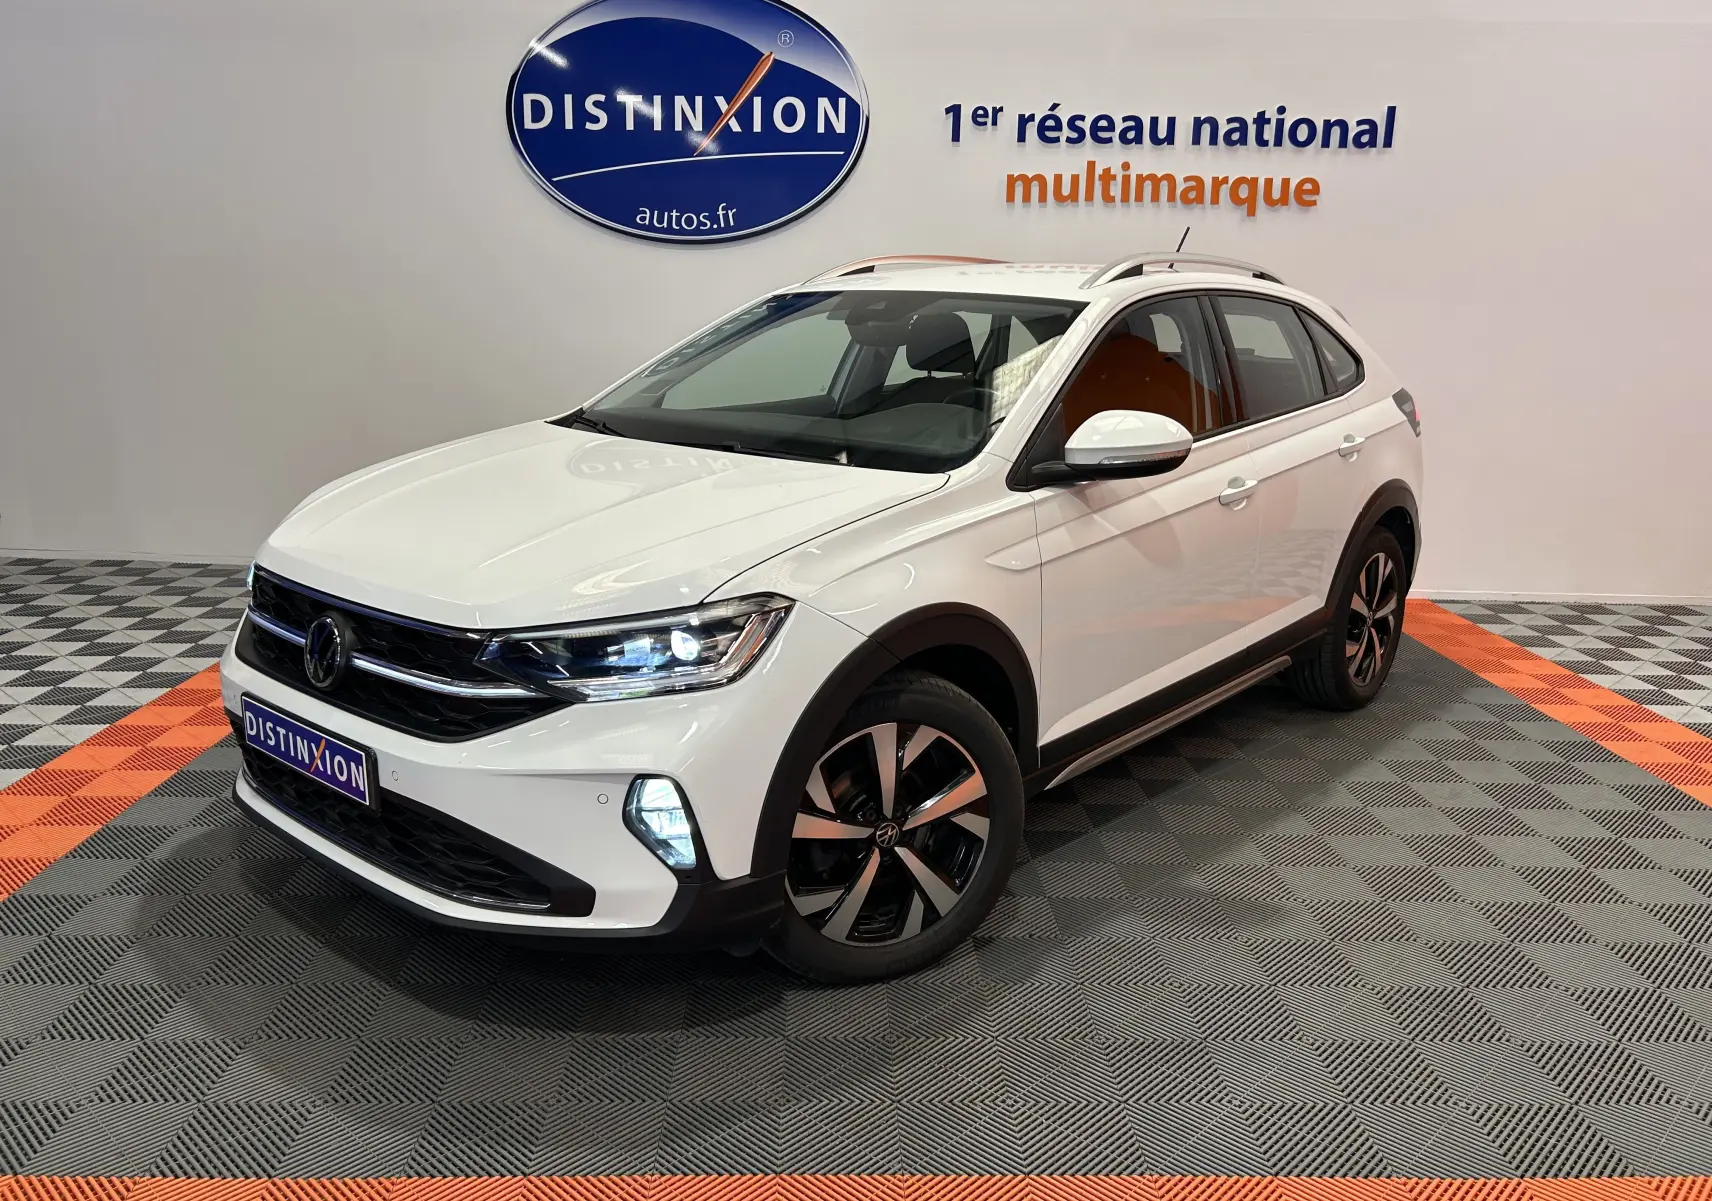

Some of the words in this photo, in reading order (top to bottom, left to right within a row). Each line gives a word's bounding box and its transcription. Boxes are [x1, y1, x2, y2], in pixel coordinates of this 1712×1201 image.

[522, 92, 846, 135] DISTINXION
[944, 103, 1004, 142] 1er
[1016, 102, 1177, 146] réseau
[1191, 105, 1397, 149] national
[1005, 160, 1321, 217] multimarque
[636, 203, 737, 230] autos.fr
[245, 710, 364, 792] DISTINXION
